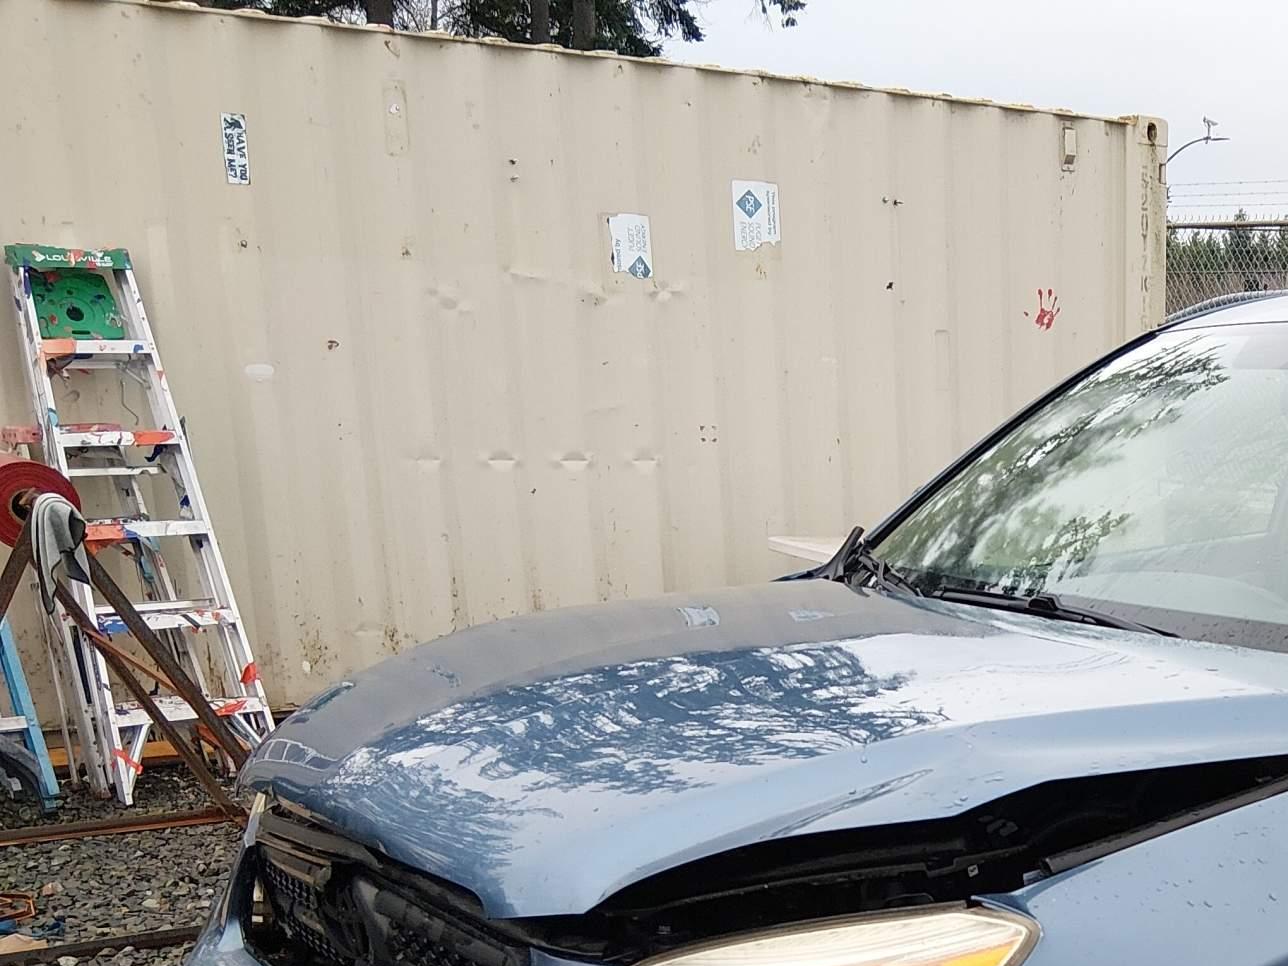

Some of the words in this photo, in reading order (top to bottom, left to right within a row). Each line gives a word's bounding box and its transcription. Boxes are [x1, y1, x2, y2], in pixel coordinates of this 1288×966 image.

[225, 132, 235, 155] SEEN
[236, 132, 246, 159] HAVE
[227, 158, 238, 178] ME?
[239, 163, 248, 181] YOU
[745, 194, 755, 213] PSE
[46, 253, 112, 263] LOUVILLE
